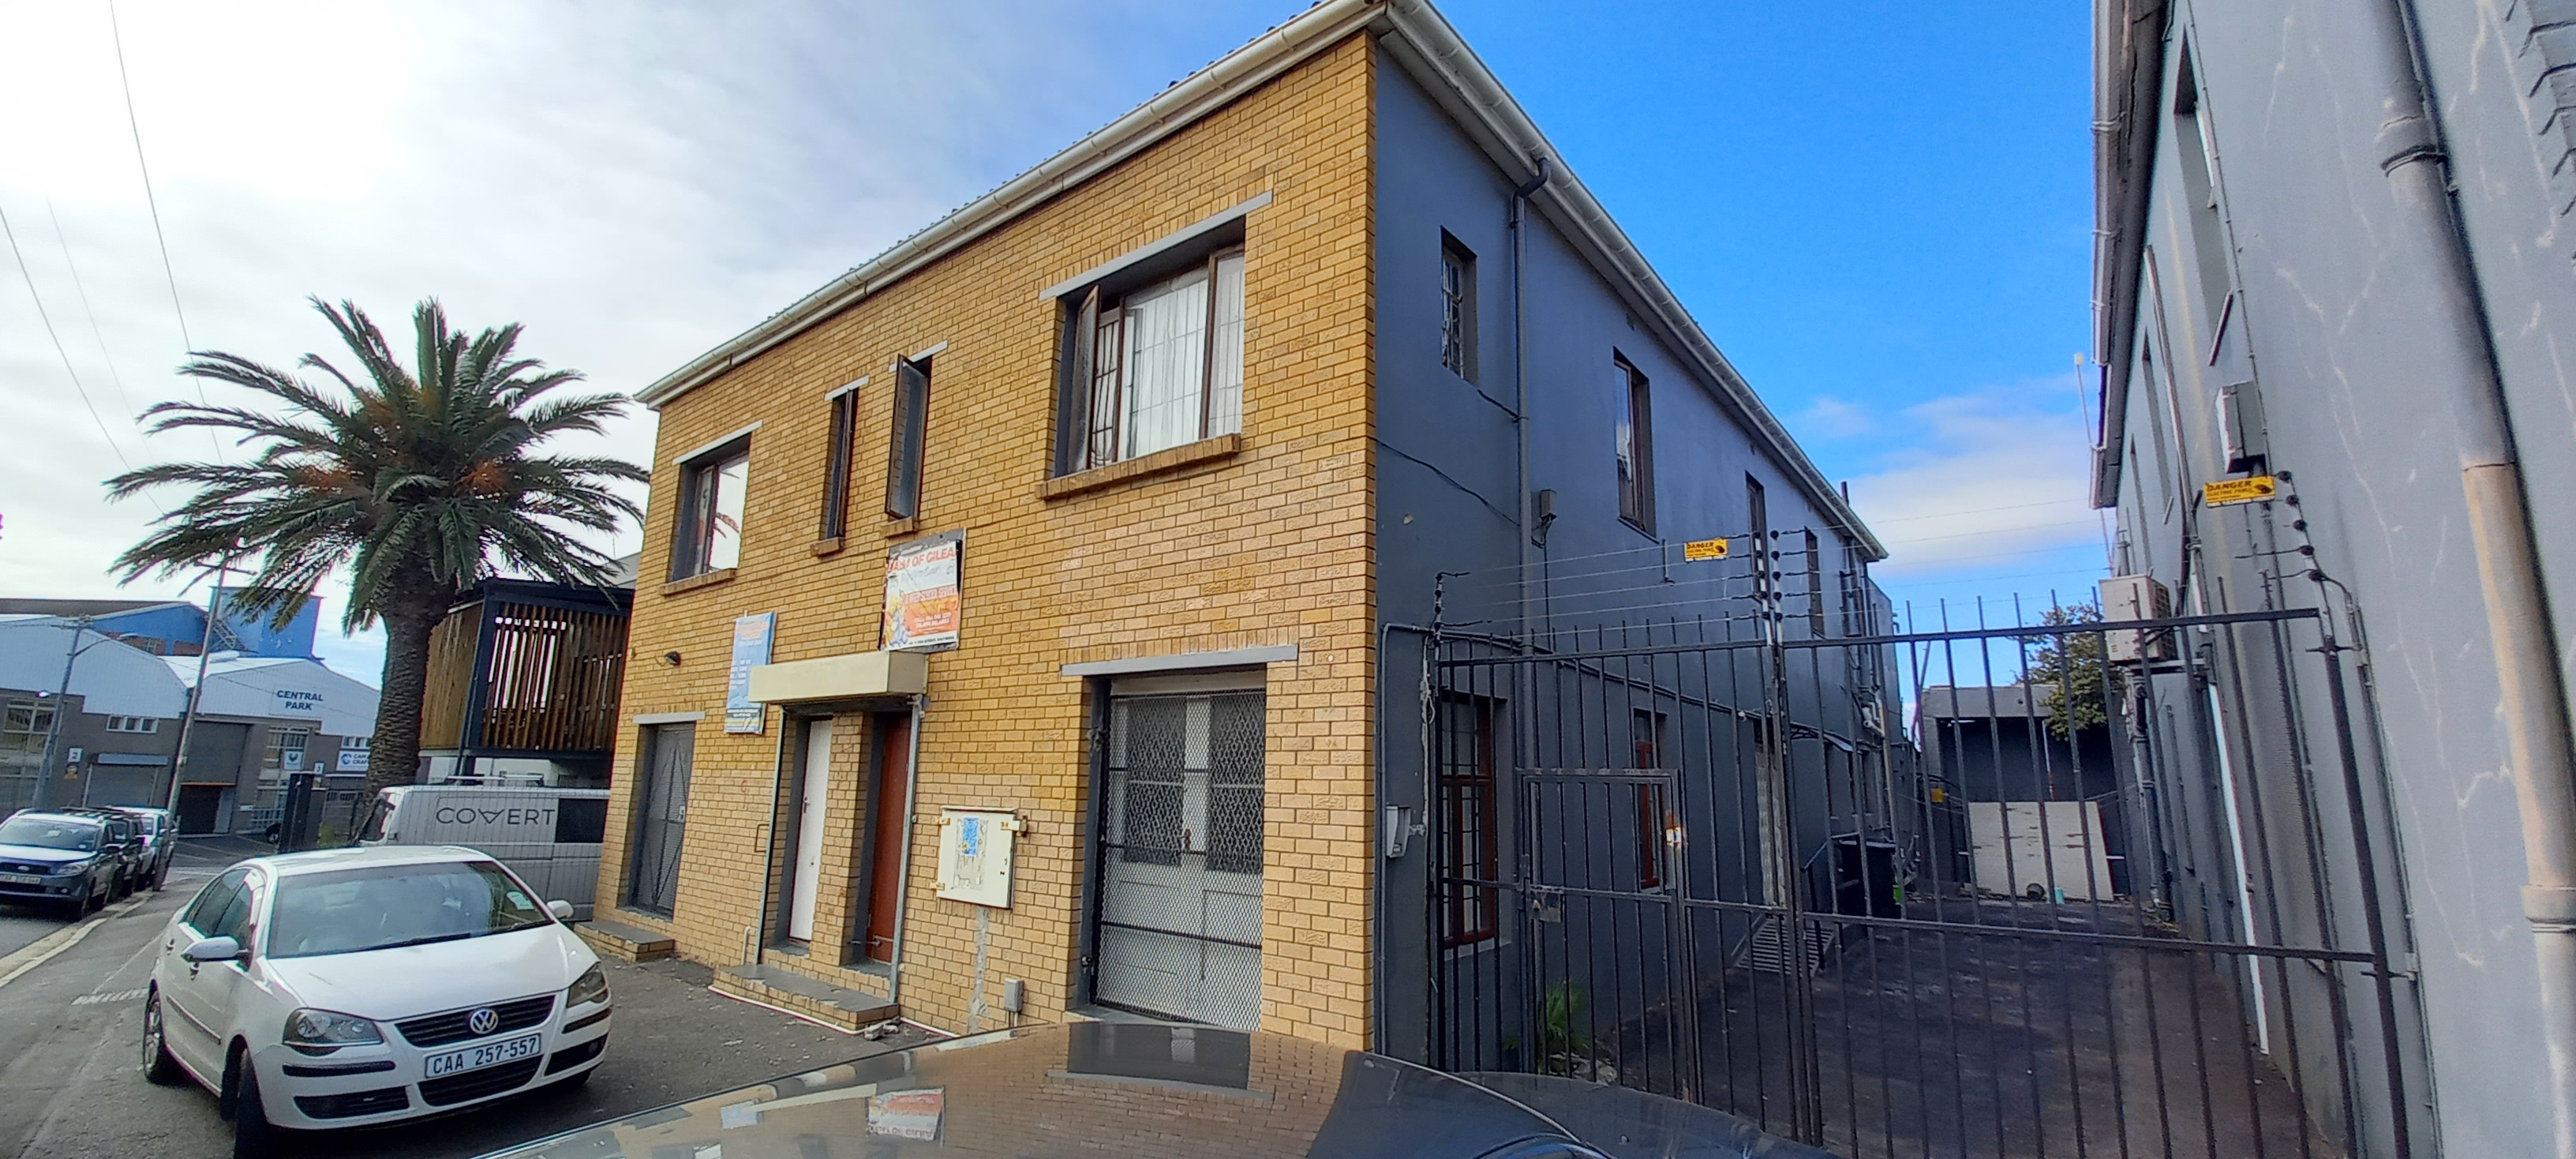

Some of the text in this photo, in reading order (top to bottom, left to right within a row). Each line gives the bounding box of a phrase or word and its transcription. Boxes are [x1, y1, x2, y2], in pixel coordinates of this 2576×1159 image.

[2207, 481, 2252, 491] DANGER
[912, 554, 924, 567] OF
[927, 547, 957, 563] GILEA
[277, 690, 324, 702] CENTRAL
[285, 702, 313, 711] PARK
[436, 808, 556, 826] COVERT
[433, 1037, 537, 1075] CAA 257-557
